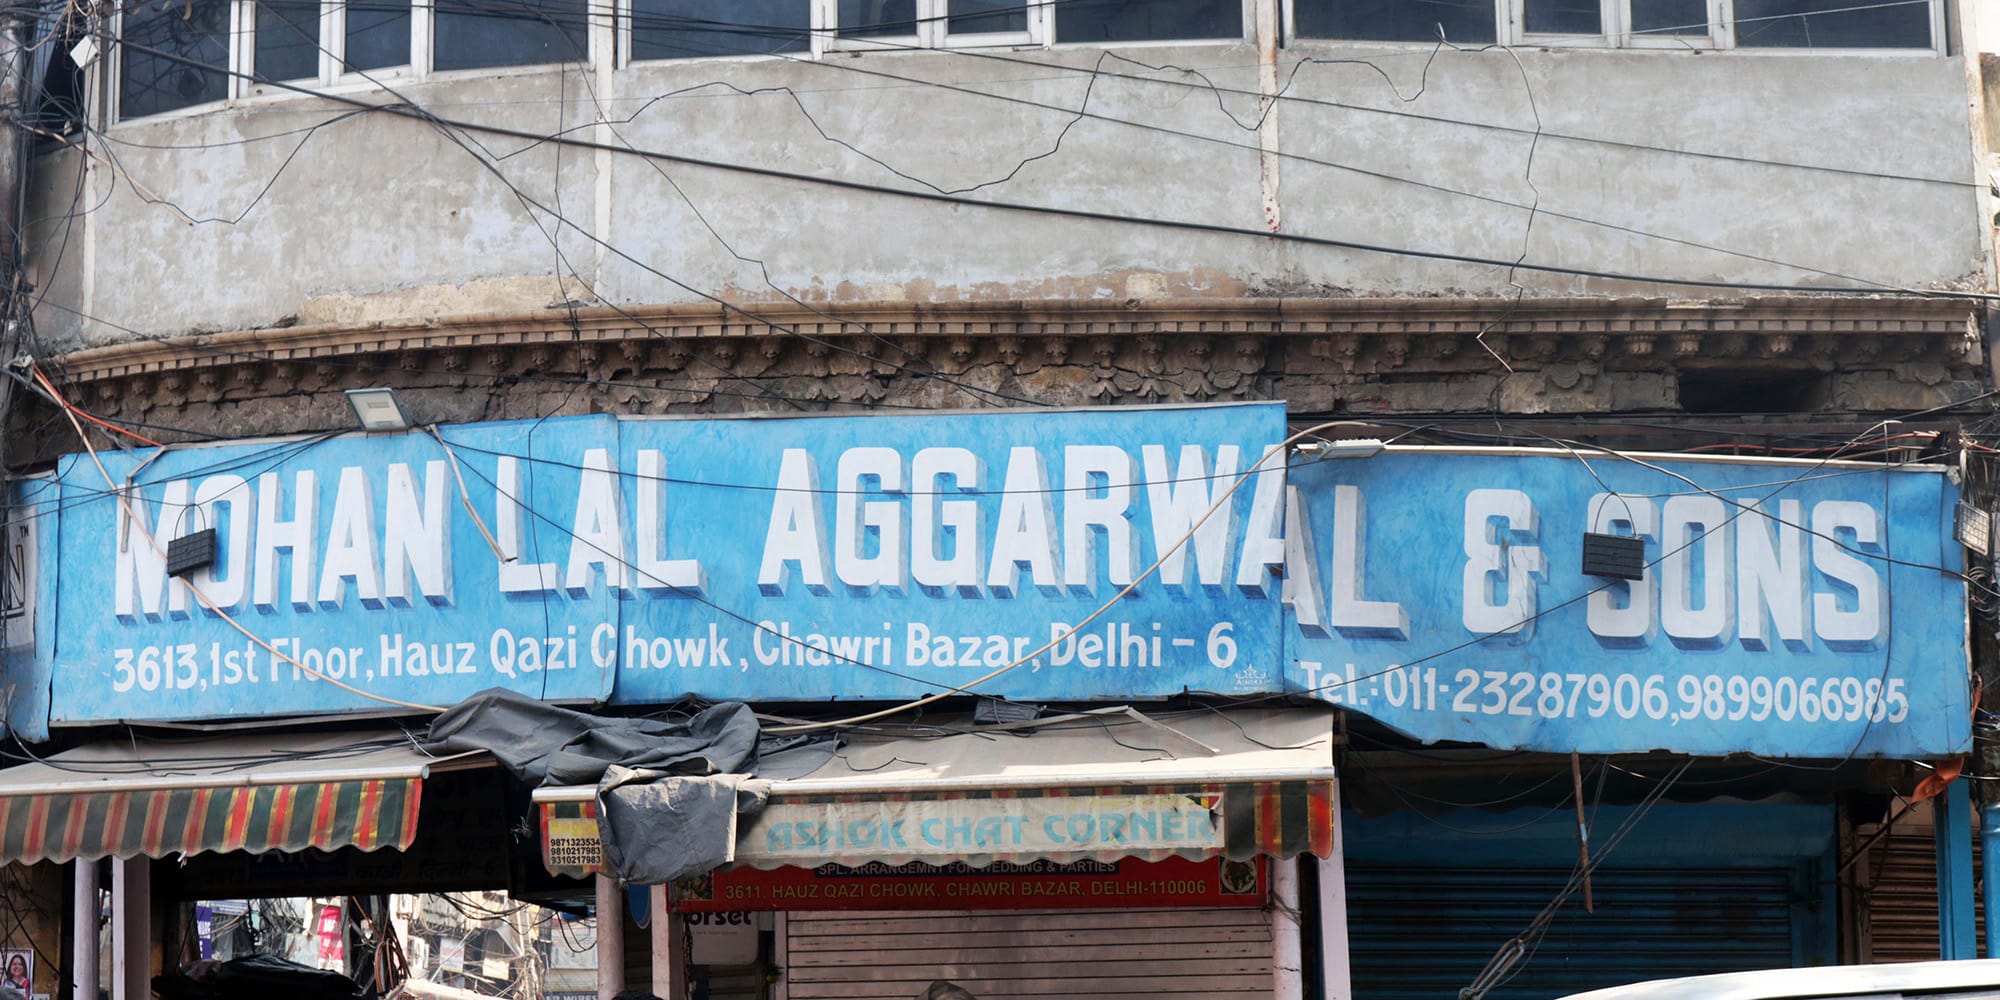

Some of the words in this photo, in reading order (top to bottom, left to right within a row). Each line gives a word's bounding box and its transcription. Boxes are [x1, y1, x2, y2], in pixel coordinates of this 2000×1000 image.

[115, 460, 456, 625] MOHAN
[497, 448, 706, 600] LAL
[1462, 488, 1549, 642] &
[1585, 493, 1890, 651] SONS
[490, 625, 577, 679] Qazi
[766, 818, 908, 853] ASHOK
[920, 814, 1029, 848] CHAT
[1043, 810, 1216, 844] CORNER
[550, 838, 601, 847] 9871323534
[550, 847, 601, 855] 9810217983
[550, 856, 601, 864] 9310217983
[1047, 861, 1056, 872] &
[1060, 860, 1116, 872] PARTIES
[772, 884, 819, 899] HAUZ
[824, 883, 864, 899] QAZI
[946, 881, 1015, 897] CHAWRI
